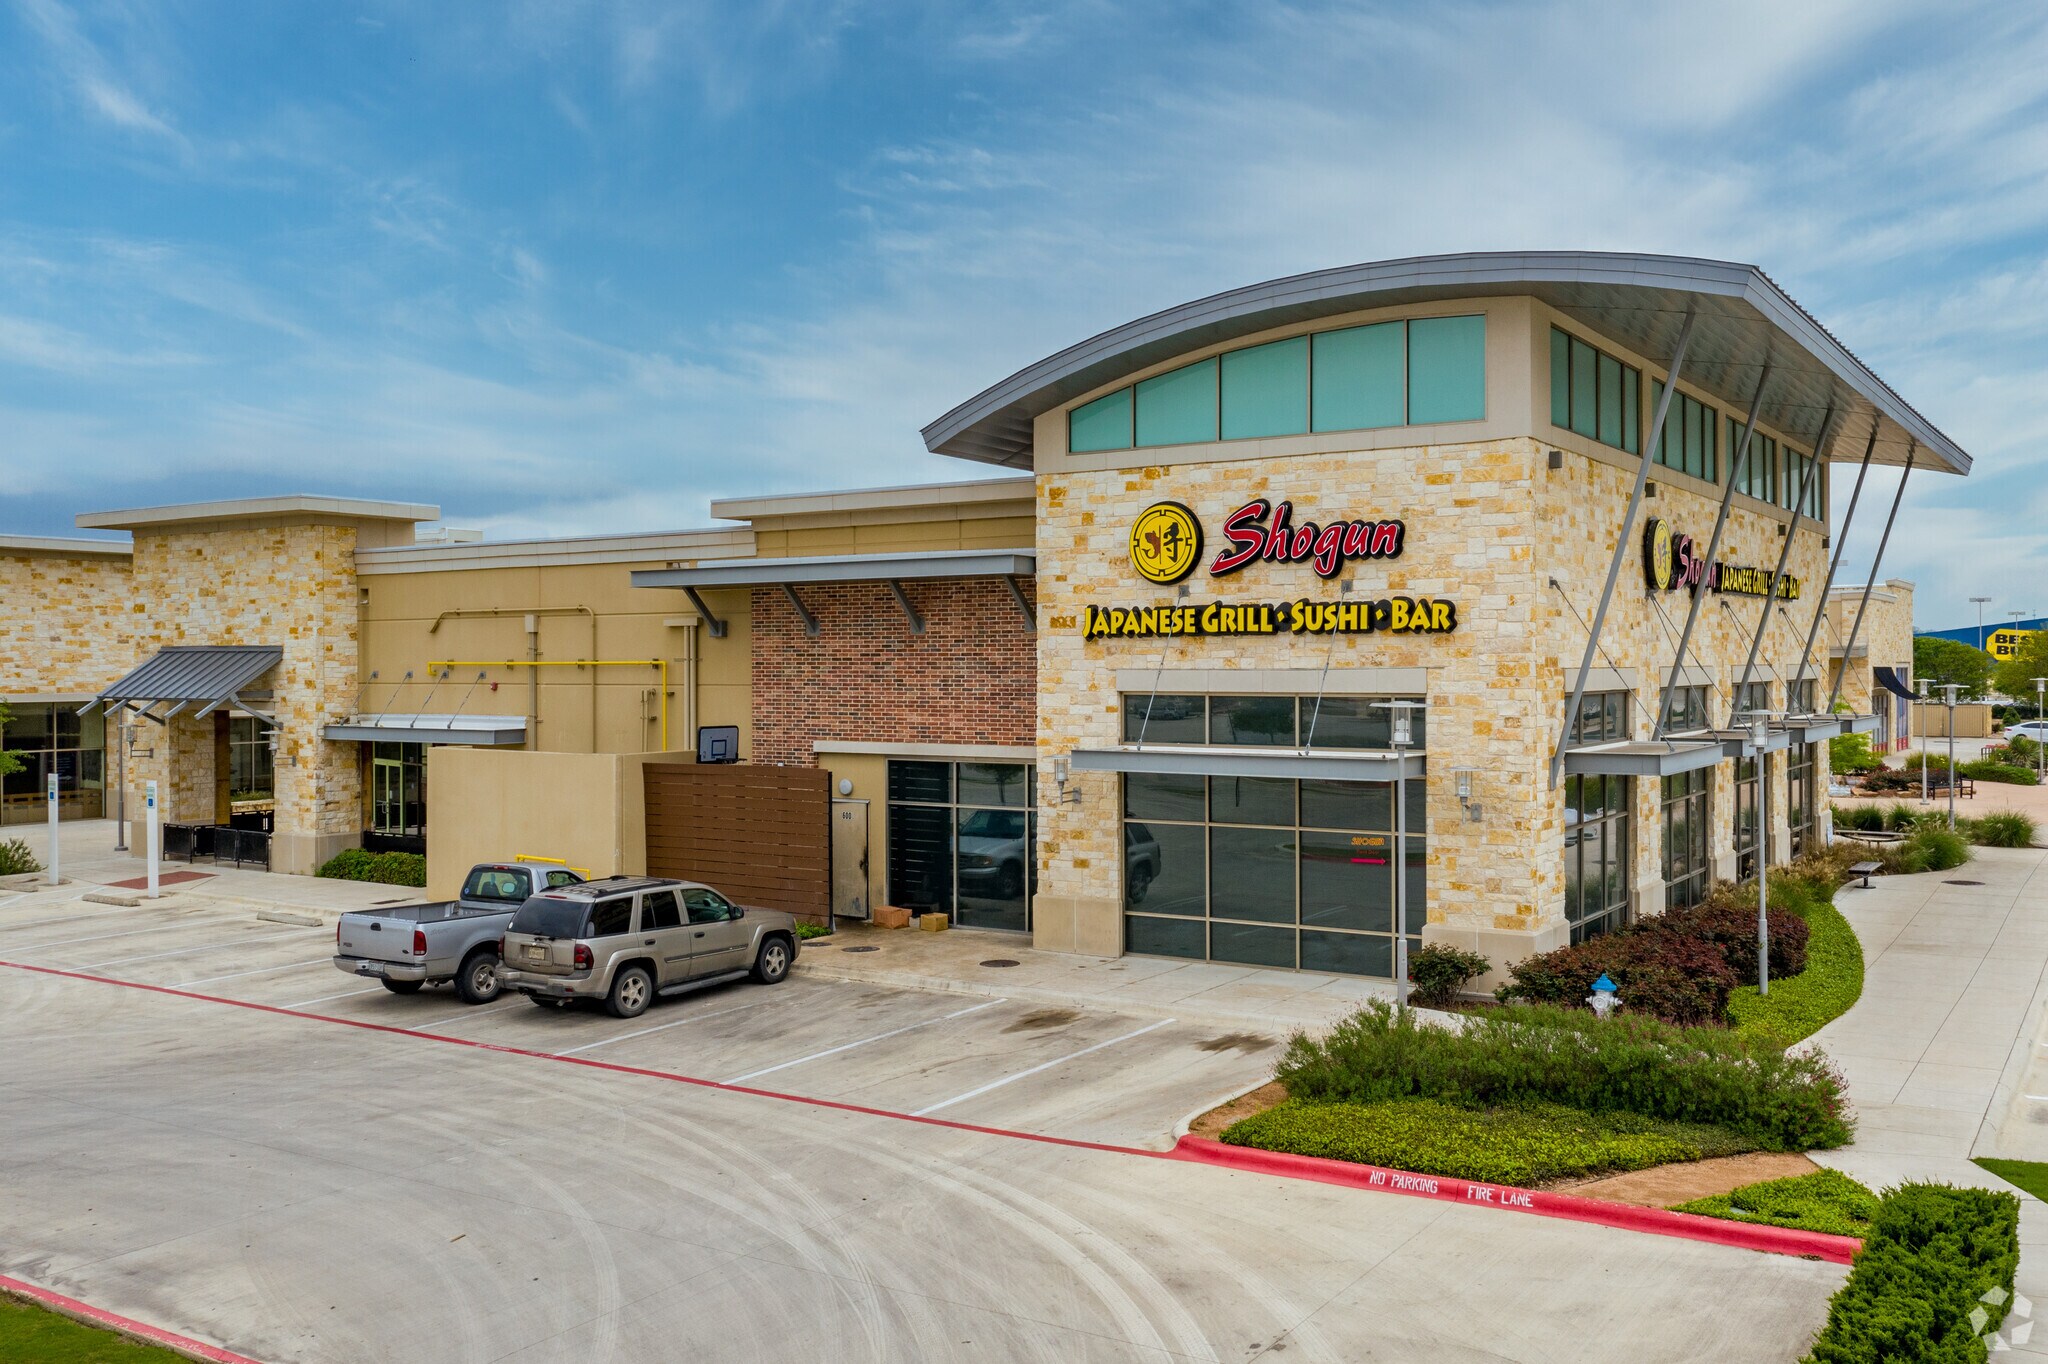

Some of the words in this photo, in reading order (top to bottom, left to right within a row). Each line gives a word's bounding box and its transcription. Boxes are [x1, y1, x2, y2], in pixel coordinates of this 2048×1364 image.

[1209, 501, 1403, 578] Shogun
[1083, 604, 1196, 637] JAPANESE
[1201, 604, 1274, 634] GRILL
[1291, 600, 1369, 633] SUSHI
[1391, 599, 1452, 631] BAR
[1369, 1170, 1386, 1185] NO
[1390, 1174, 1438, 1194] PARKING
[1467, 1185, 1496, 1202] FIRE
[1500, 1190, 1534, 1208] LANE
